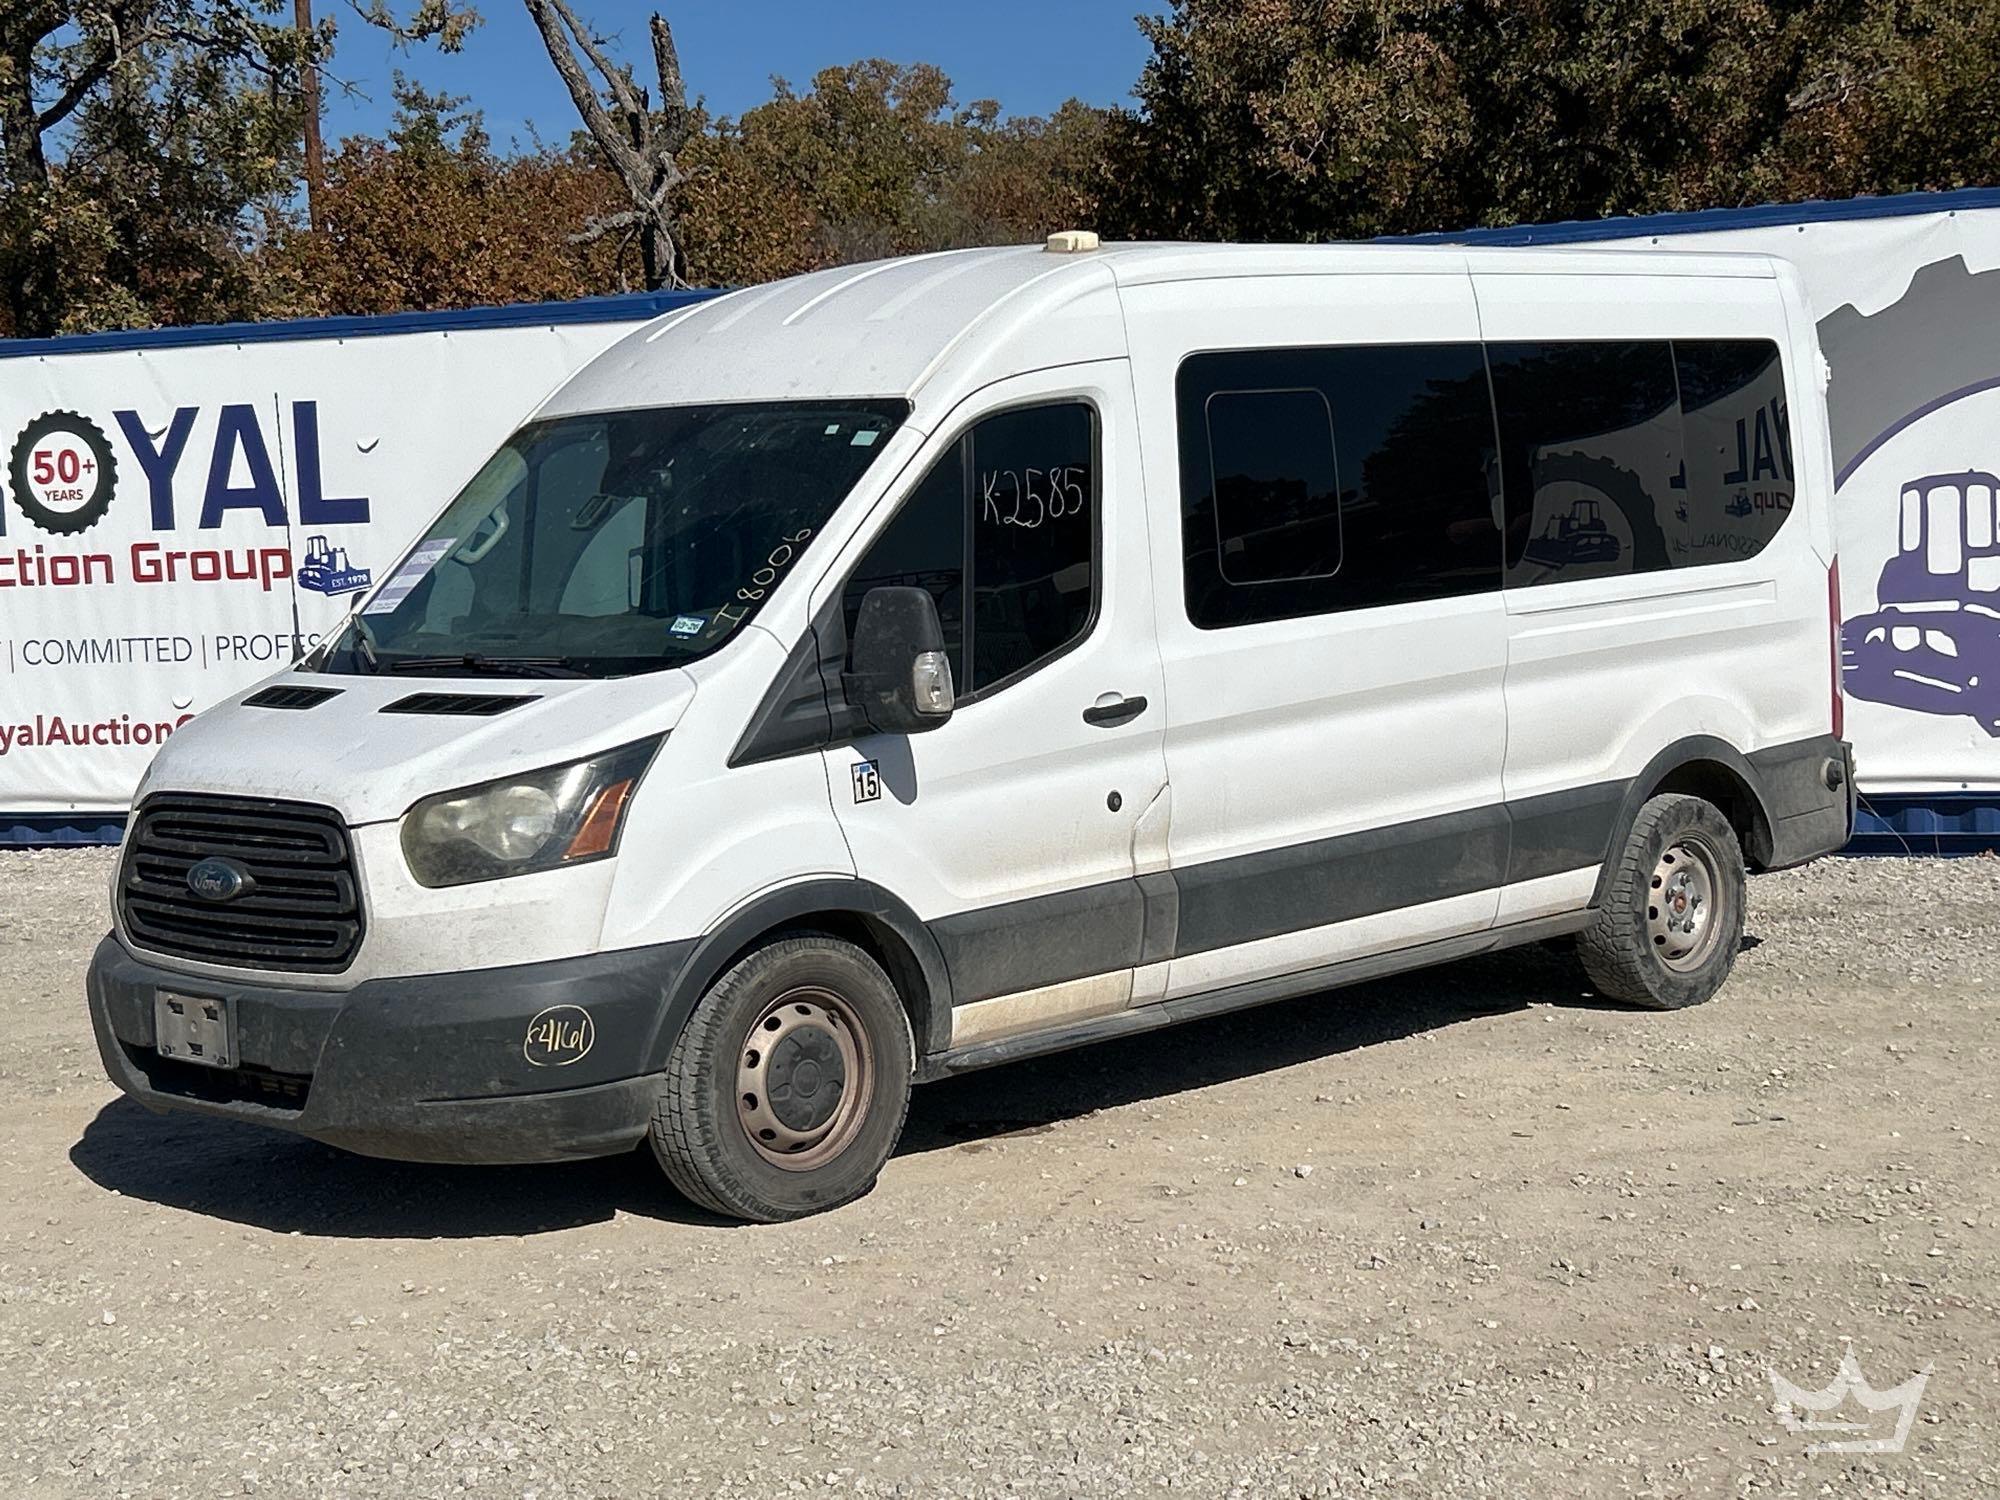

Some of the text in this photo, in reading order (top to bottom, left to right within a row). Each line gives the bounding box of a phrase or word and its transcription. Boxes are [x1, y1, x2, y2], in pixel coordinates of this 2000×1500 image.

[33, 449, 95, 485] 50+
[44, 489, 83, 502] YEARS
[131, 543, 292, 591] Group
[347, 574, 368, 584] 1970
[22, 637, 193, 665] COMMITTED
[856, 771, 877, 798] 15
[195, 865, 226, 891] Ford
